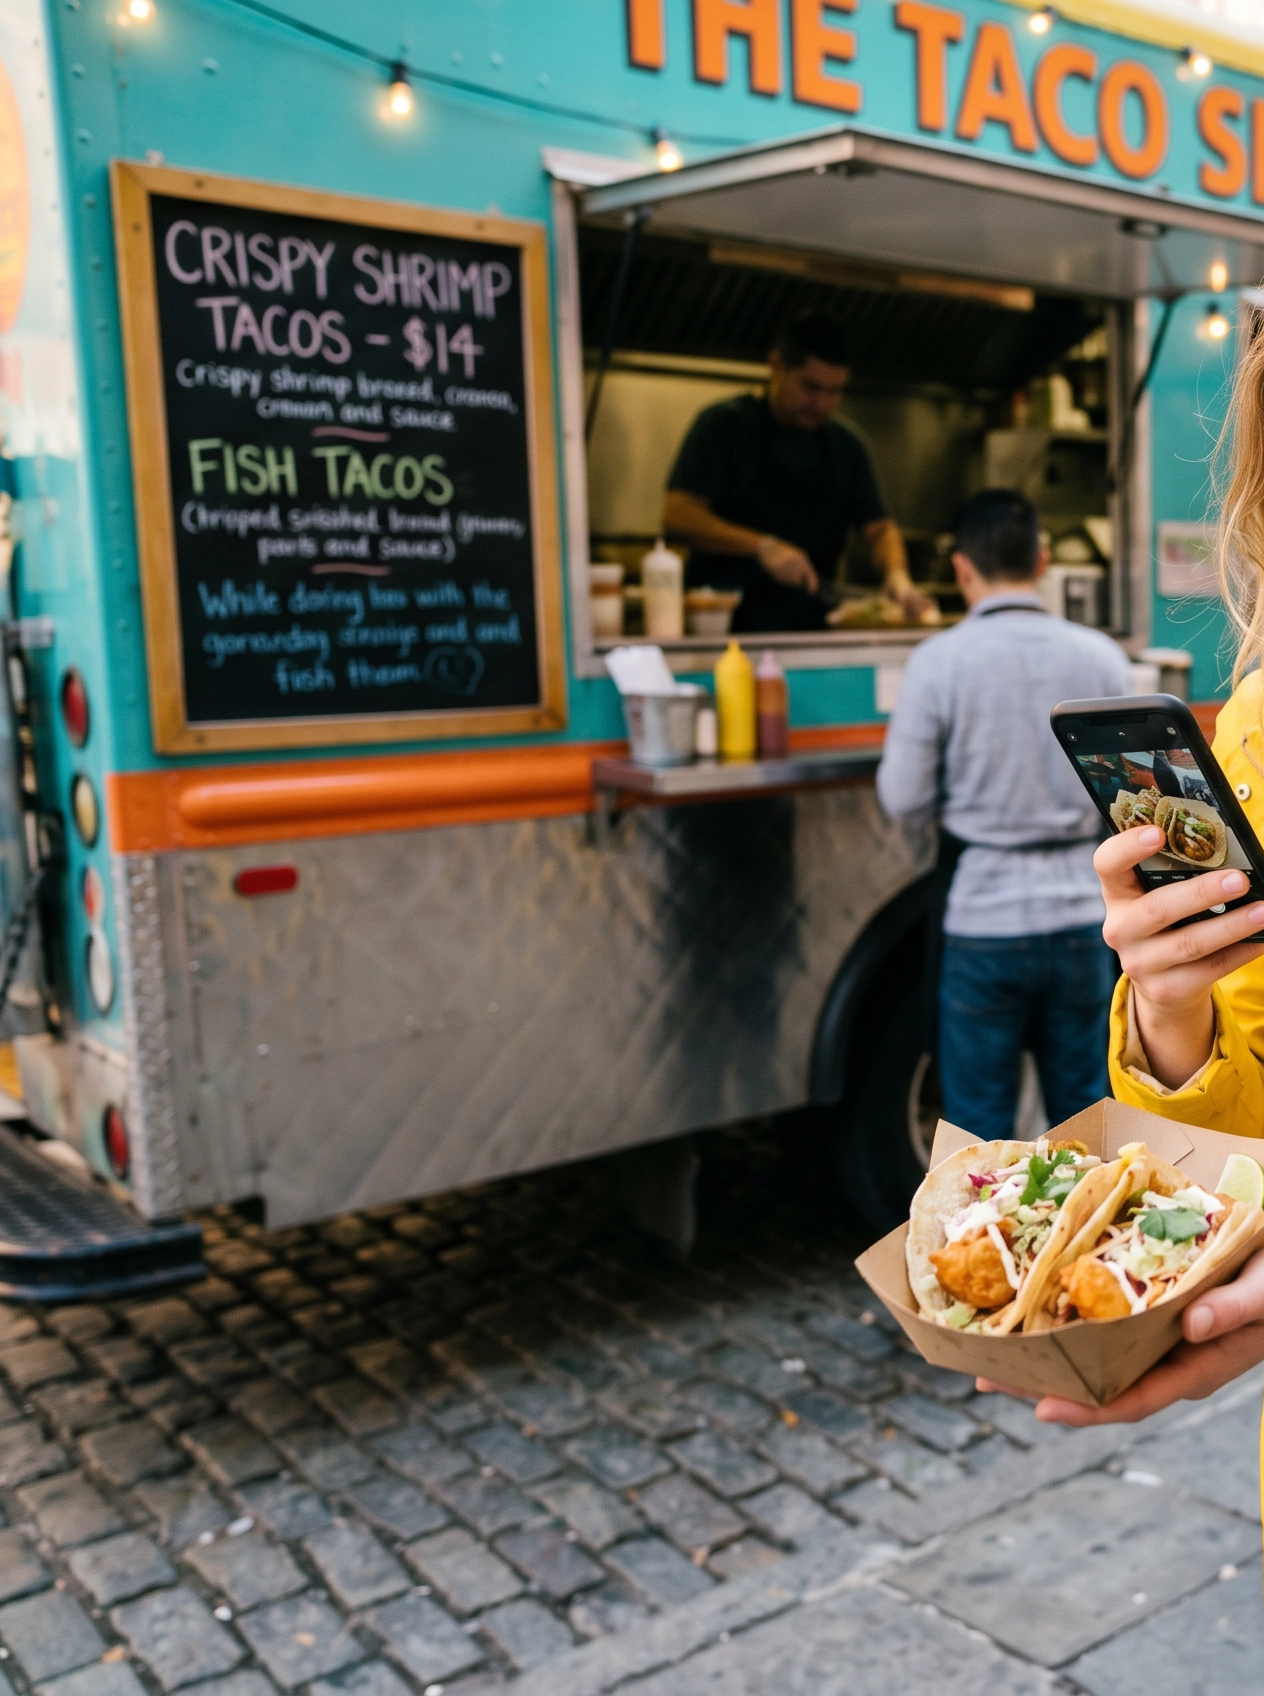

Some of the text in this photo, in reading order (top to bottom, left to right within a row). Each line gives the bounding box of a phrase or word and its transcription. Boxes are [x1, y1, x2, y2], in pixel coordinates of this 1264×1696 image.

[895, 2, 1169, 178] TACO
[165, 220, 512, 320] CRISPY SHRIMP
[196, 296, 352, 364] TACOS
[402, 316, 484, 379] $14
[176, 358, 263, 398] Crispy
[269, 363, 352, 403] shrimp
[340, 402, 384, 425] and
[188, 438, 454, 506] FISH TACOS
